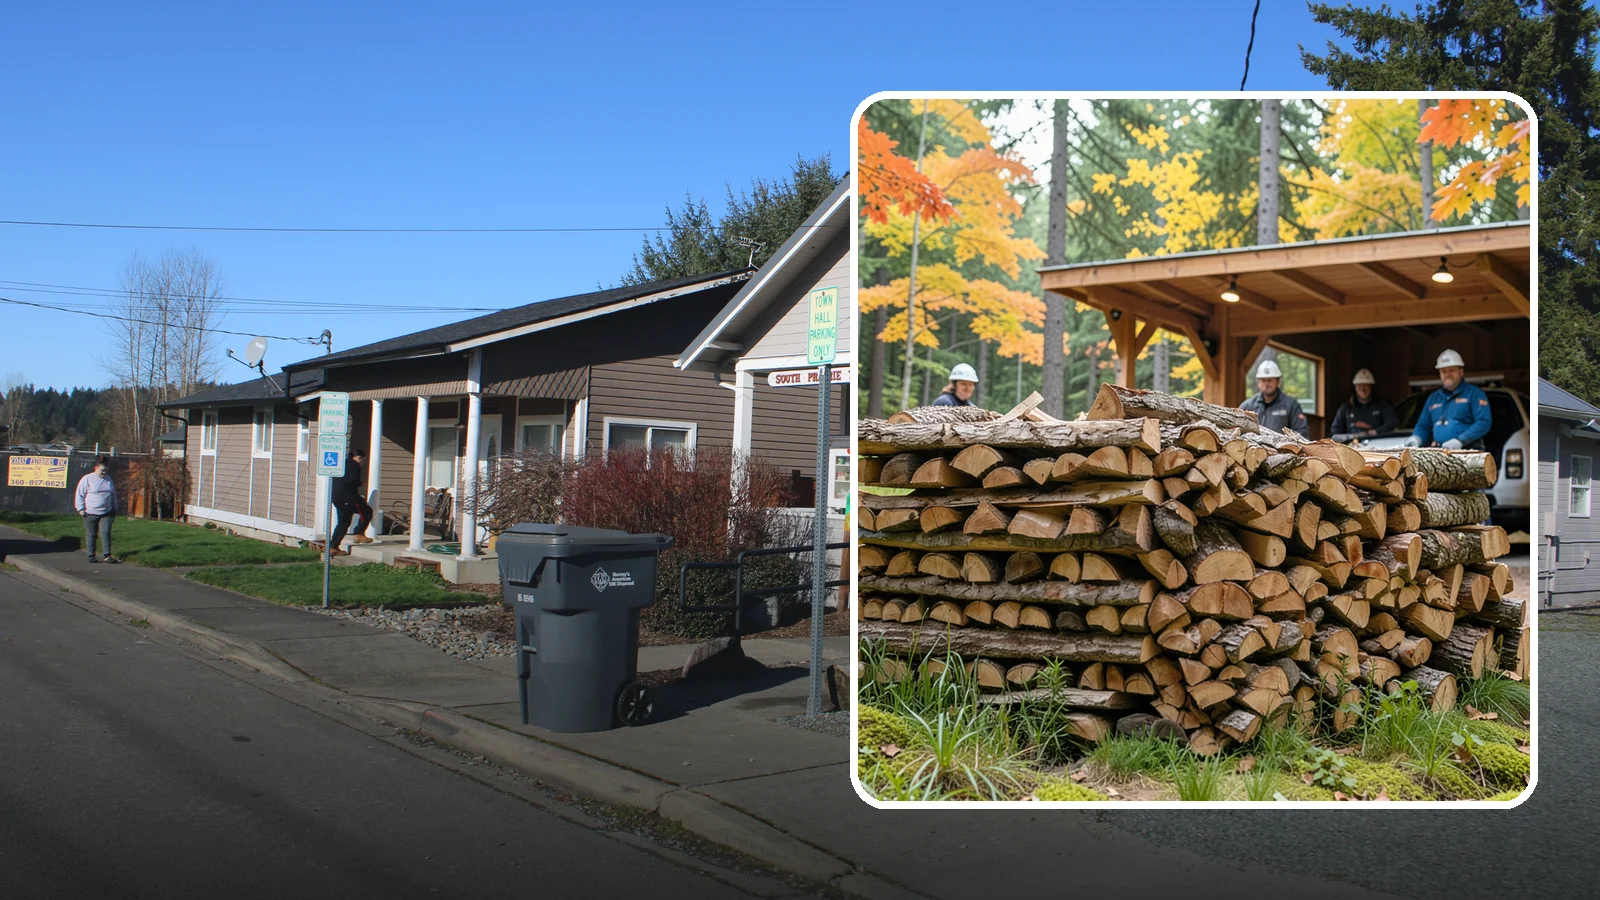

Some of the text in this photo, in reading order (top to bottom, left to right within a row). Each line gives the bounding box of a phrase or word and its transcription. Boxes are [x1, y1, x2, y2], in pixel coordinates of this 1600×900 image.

[814, 294, 832, 308] TOWN
[814, 312, 830, 324] HALL
[810, 326, 835, 340] PARKING
[814, 344, 830, 357] ONLY
[776, 374, 800, 384] SOUTH
